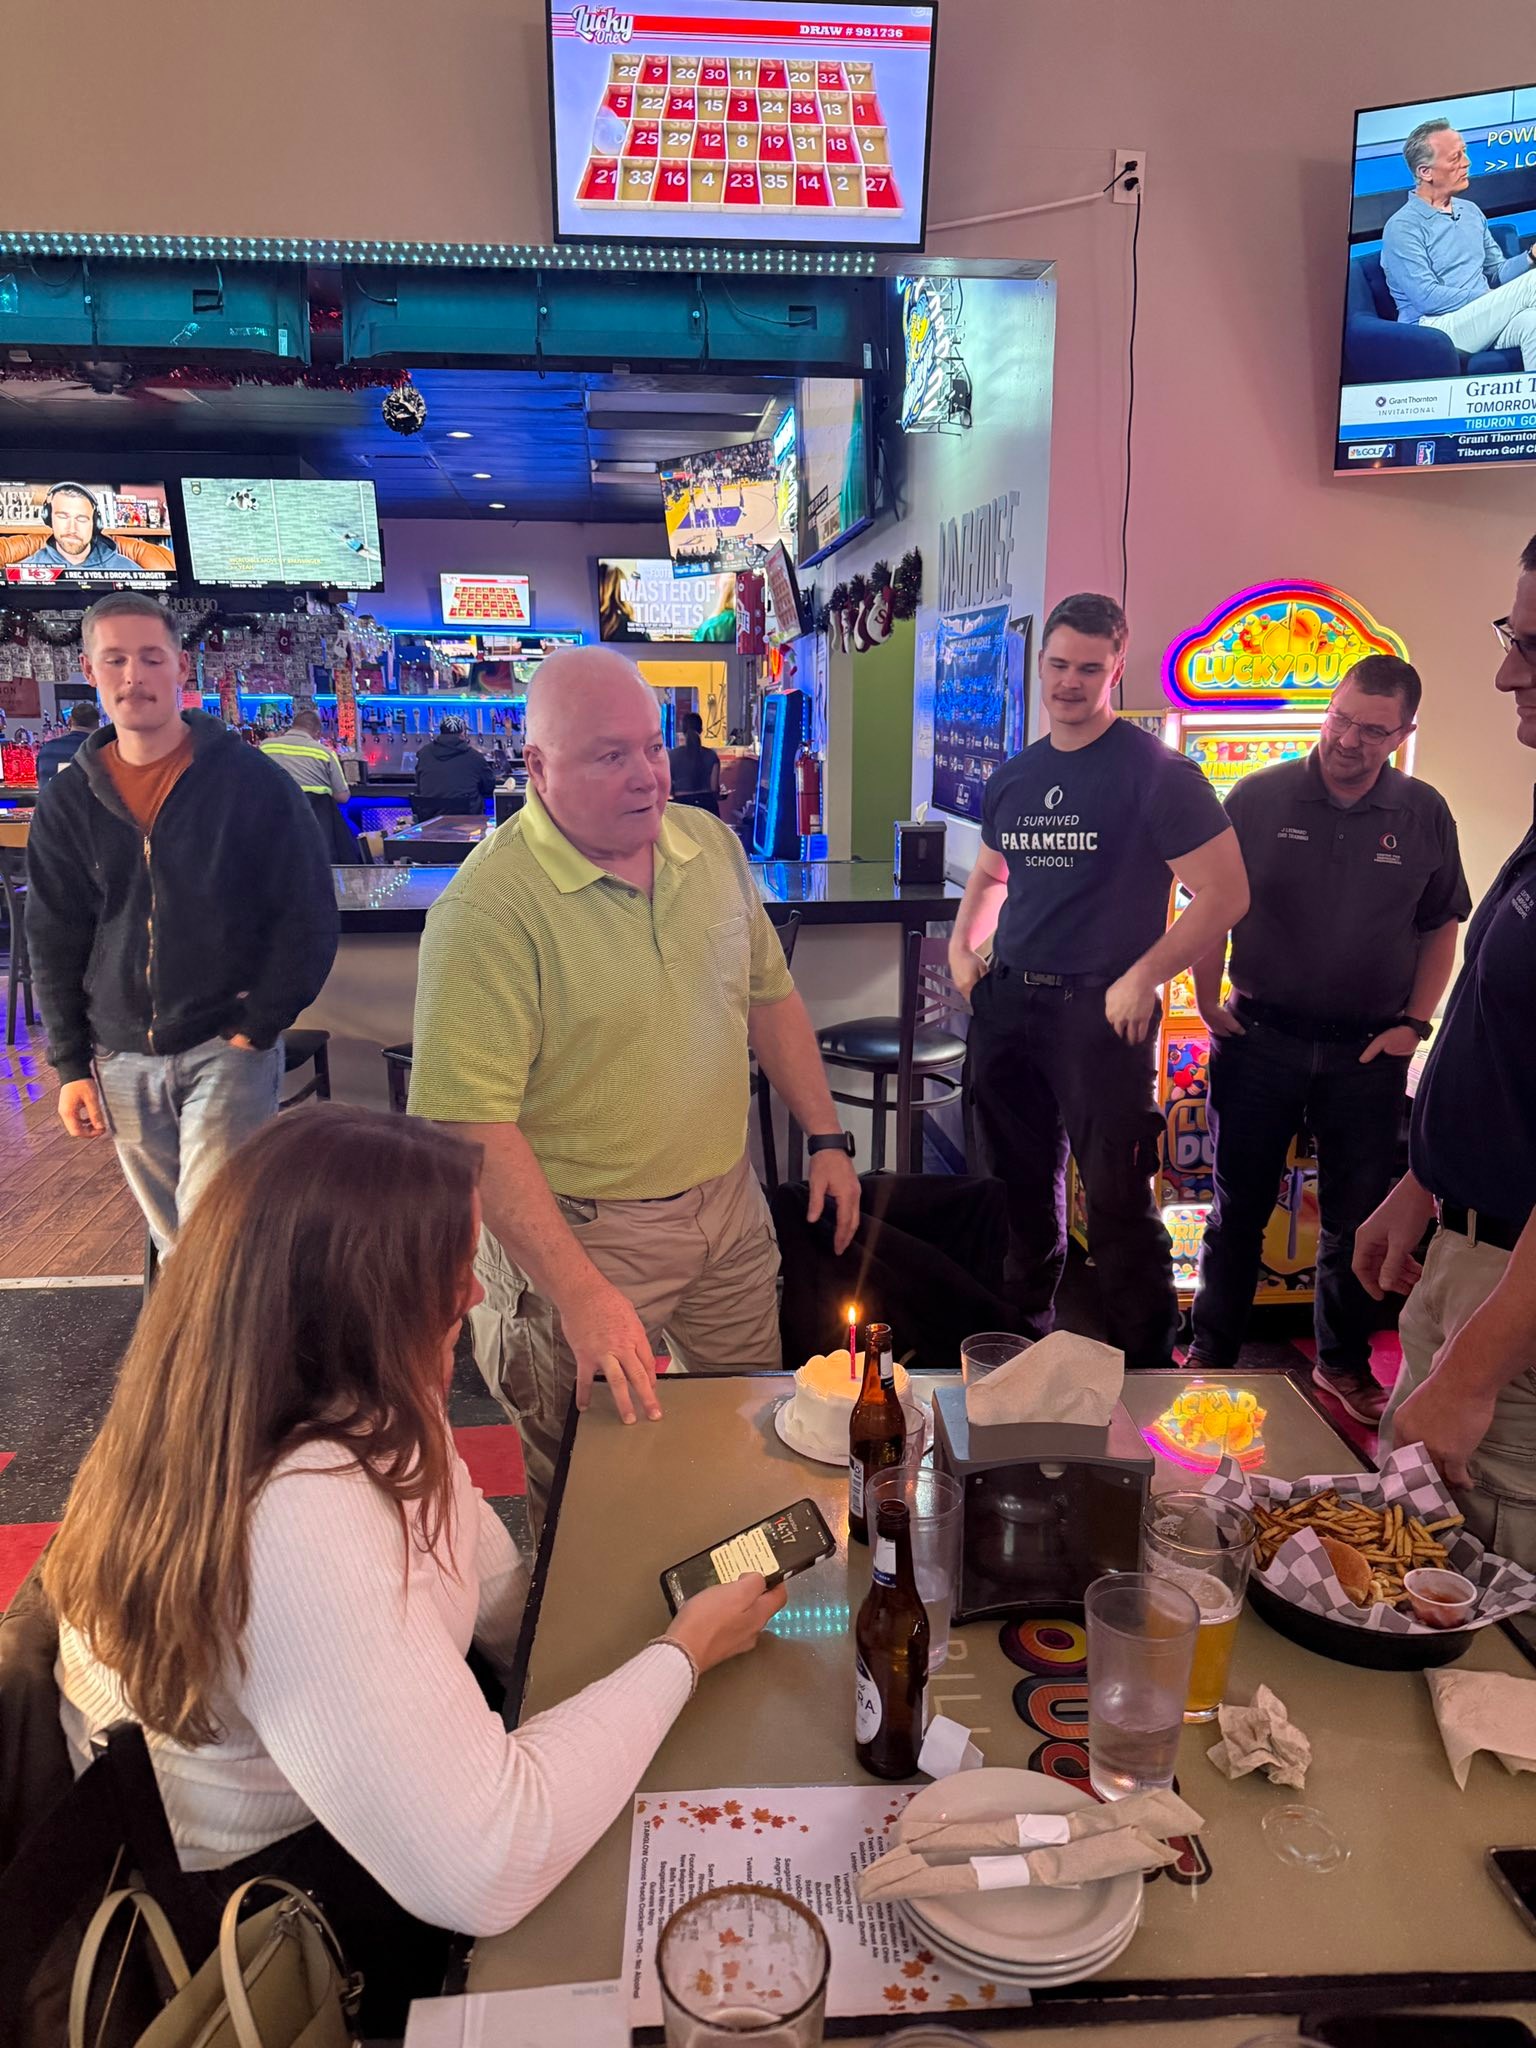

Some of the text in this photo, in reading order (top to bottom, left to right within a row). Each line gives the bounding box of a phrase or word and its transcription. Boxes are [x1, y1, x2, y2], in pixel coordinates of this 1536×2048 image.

[571, 5, 635, 43] Lucky
[799, 25, 904, 38] DRAW # 981736
[596, 30, 620, 44] One
[618, 66, 865, 85] 28 9 26 30 11 7 20 32 17
[616, 97, 865, 117] 5 22 34 15 3 24 36 13 1
[634, 131, 875, 152] 25 29 12 8 19 31 18 6
[594, 170, 887, 192] 21 33 16 4 23 35 14 2 27
[1466, 380, 1522, 397] Grant
[1378, 406, 1435, 417] INVITATIONAL
[1464, 417, 1516, 430] TIBURON
[1458, 435, 1489, 445] Grant
[1361, 446, 1384, 457] GOLF
[1457, 447, 1499, 458] Tiburon
[1501, 444, 1525, 455] Golf
[139, 572, 166, 580] TARGETS
[620, 580, 716, 603] MASTER OF
[634, 603, 704, 626] TICKETS
[1194, 653, 1294, 686] LUCKY
[1016, 814, 1080, 827] I SURVIVED
[1001, 831, 1098, 851] PARAMEDIC
[1025, 855, 1074, 868] SCHOOL!
[774, 1516, 798, 1544] 14:17
[642, 1820, 651, 1857] STARGLOW
[688, 1853, 696, 1882] Founders
[773, 1856, 781, 1876] Angry
[638, 1881, 647, 1902] Peach
[833, 1875, 843, 1905] Michelob
[845, 1905, 854, 1925] Lager
